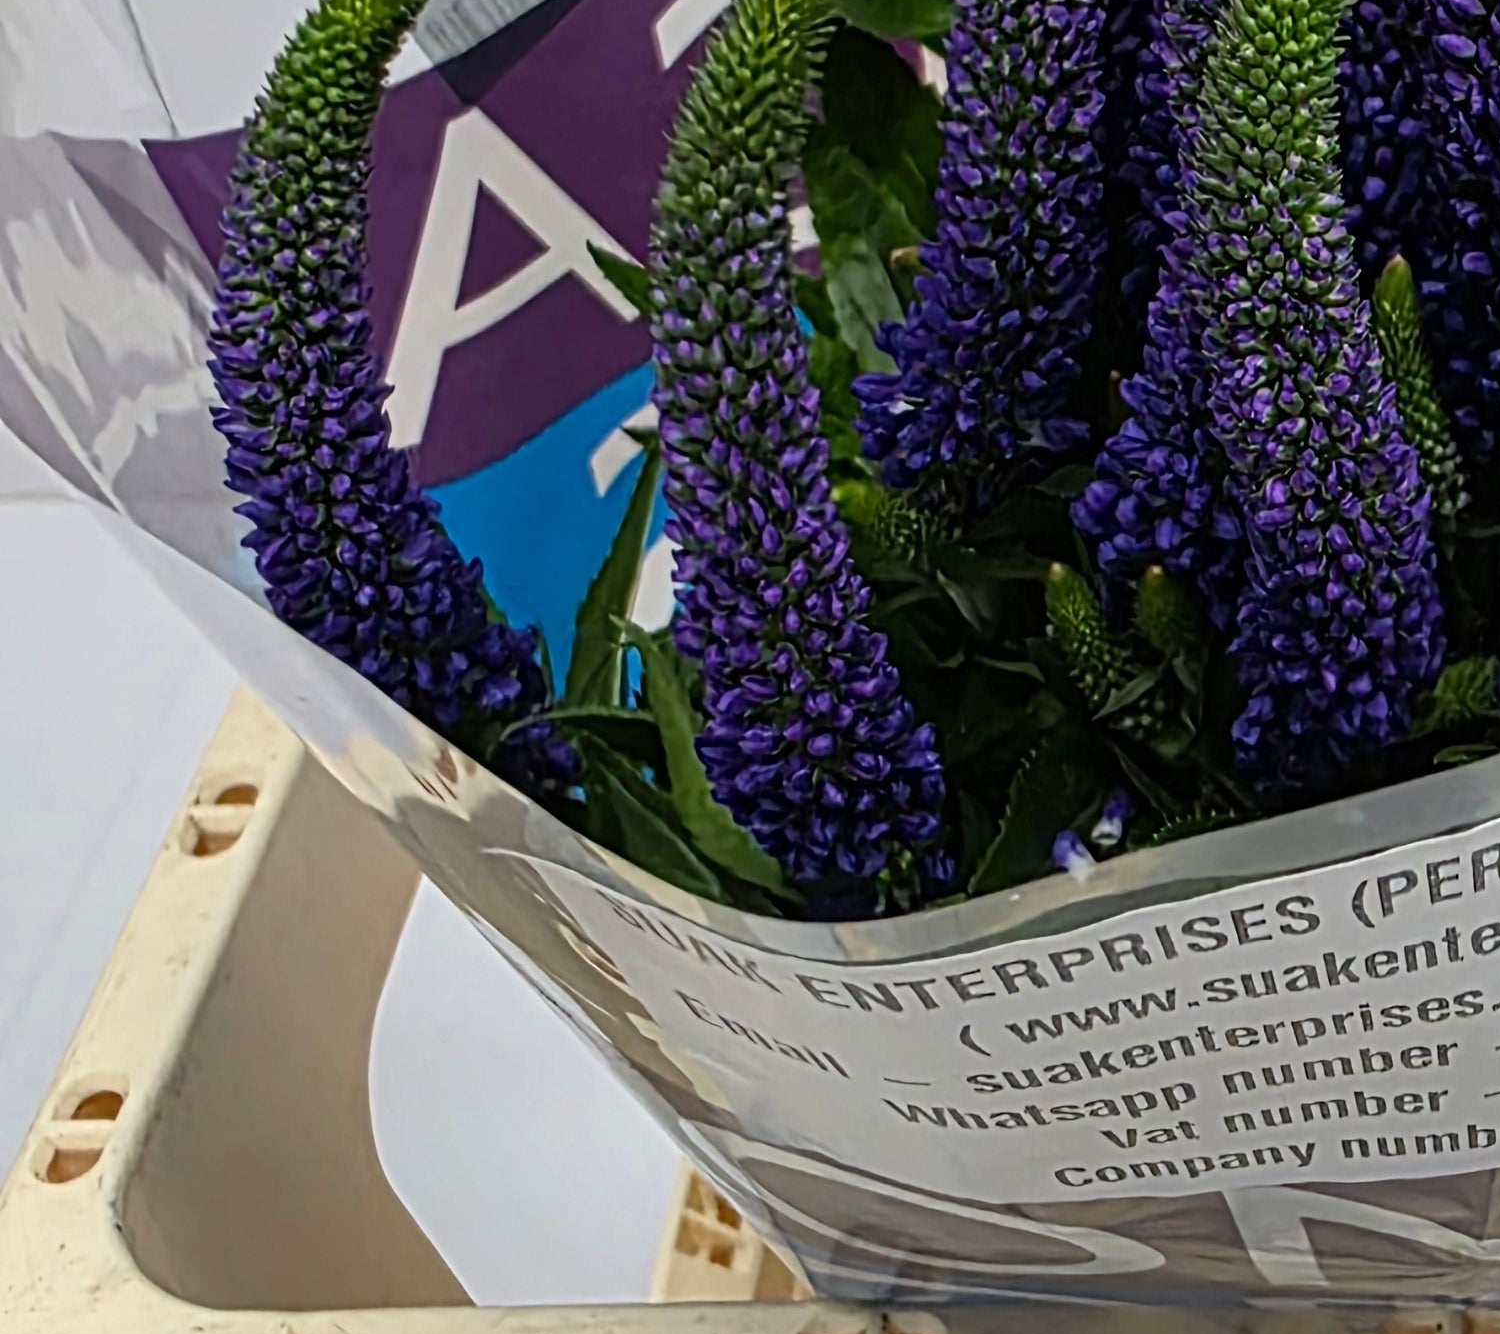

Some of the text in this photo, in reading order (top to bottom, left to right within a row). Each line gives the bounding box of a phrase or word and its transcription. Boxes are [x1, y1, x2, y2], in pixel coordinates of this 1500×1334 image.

[596, 889, 783, 995] SUAK
[795, 895, 1321, 1012] ENTERPRISES
[675, 989, 851, 1079] Email
[882, 1080, 1198, 1130] Whatsapp
[1222, 1040, 1459, 1096] number
[1100, 1119, 1201, 1150] Vat
[1223, 1088, 1449, 1135] number
[1054, 1140, 1316, 1189] Company
